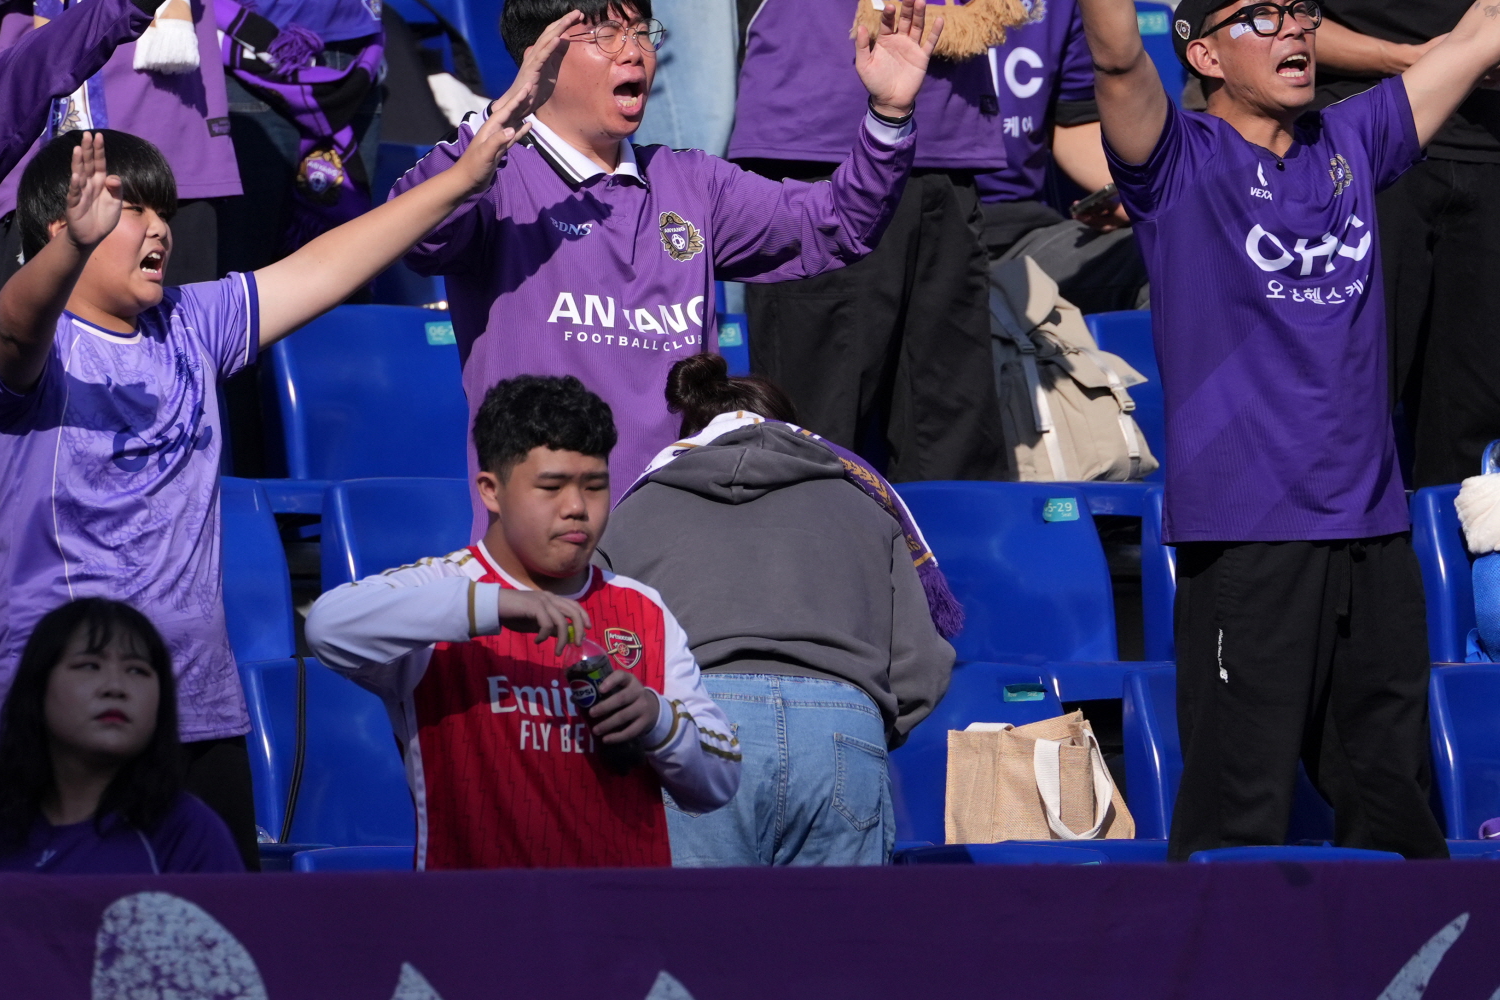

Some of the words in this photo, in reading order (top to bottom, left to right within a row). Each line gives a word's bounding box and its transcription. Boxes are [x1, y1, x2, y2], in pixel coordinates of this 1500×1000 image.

[1250, 187, 1273, 200] VEXX
[664, 226, 686, 234] ANYANG
[1246, 213, 1371, 275] OHC
[564, 332, 658, 350] FOOTBALL
[520, 720, 551, 752] FLY
